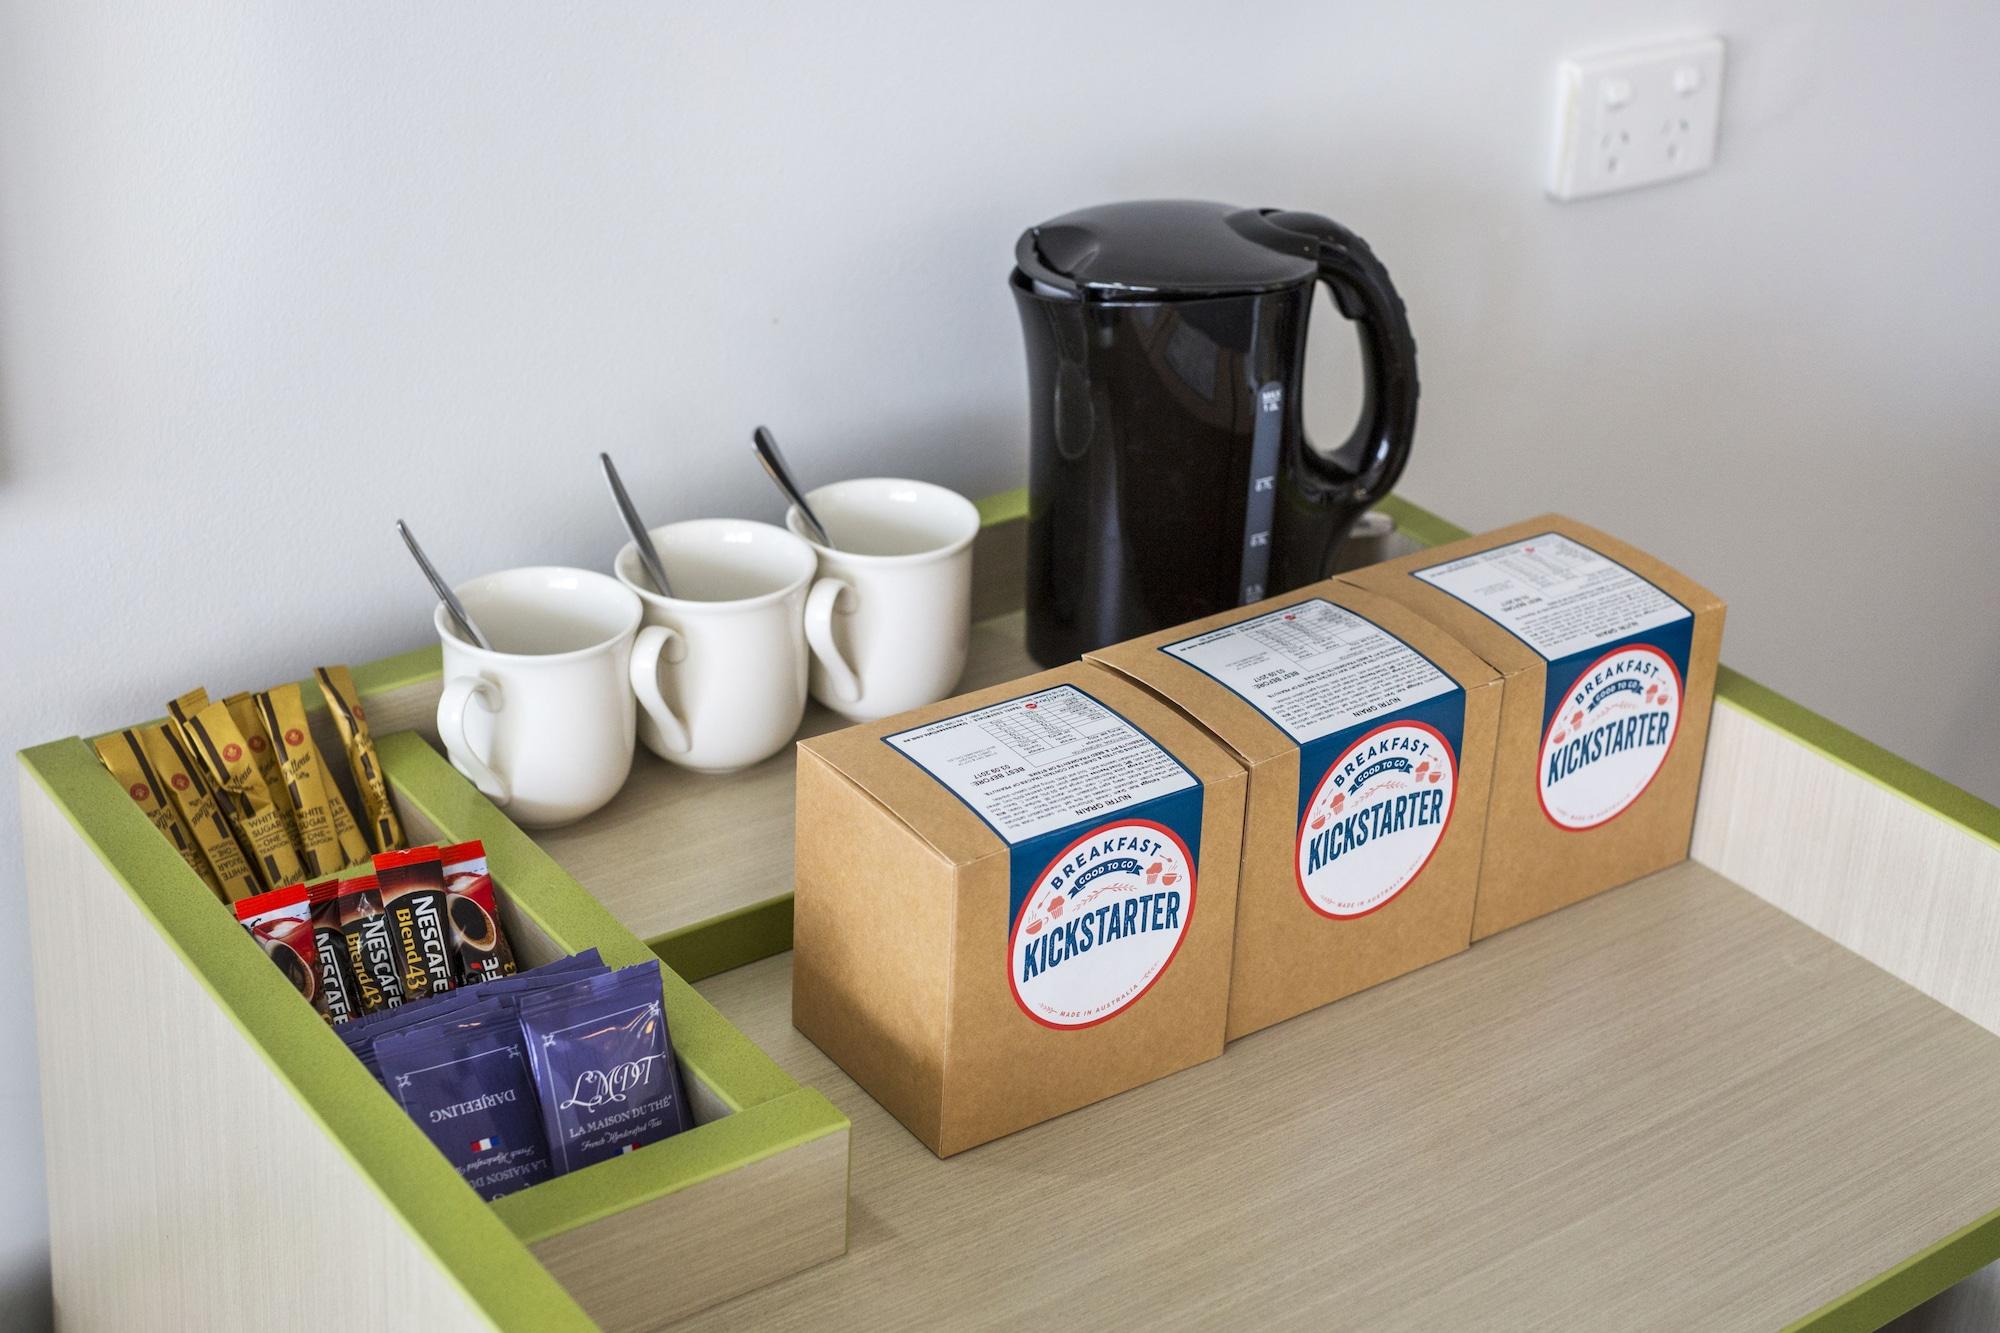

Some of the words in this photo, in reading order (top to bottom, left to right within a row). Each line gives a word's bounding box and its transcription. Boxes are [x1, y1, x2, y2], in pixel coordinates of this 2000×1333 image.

[1279, 670, 1301, 679] BEST
[1575, 660, 1659, 704] BREAKFAST
[1595, 686, 1616, 701] GOOD
[1628, 681, 1638, 689] GO
[1375, 696, 1403, 707] NUTRI
[1349, 704, 1380, 717] GRAIN
[1547, 712, 1670, 788] KICKSTARTER
[1004, 766, 1026, 775] BEST
[1334, 738, 1429, 787] BREAKFAST
[1357, 766, 1380, 782] GOOD
[1394, 760, 1406, 768] GO
[1103, 793, 1133, 805] NUTRI
[297, 806, 323, 819] WHITE
[1073, 803, 1105, 815] GRAIN
[248, 811, 278, 829] WHITE
[301, 816, 327, 830] SUGAR
[252, 821, 282, 837] SUGAR
[1308, 789, 1443, 876] KICKSTARTER
[263, 835, 280, 846] ONE
[217, 858, 244, 871] SUGAR
[1051, 836, 1162, 890] BREAKFAST
[221, 866, 249, 880] WHITE
[1079, 866, 1104, 885] GOOD
[1107, 862, 1119, 870] TO
[1121, 860, 1134, 870] GO
[1023, 891, 1180, 982] KICKSTARTER
[1060, 1008, 1082, 1018] MADE
[1084, 1008, 1093, 1017] IN
[1095, 984, 1138, 1014] AUSTRALIA
[429, 1089, 516, 1123] DARJEELING
[568, 1126, 586, 1138] LA
[587, 1110, 631, 1132] MAISON
[631, 1104, 648, 1118] DU
[580, 1138, 606, 1152] French
[530, 1158, 548, 1171] LA
[486, 1164, 530, 1185] MAISON
